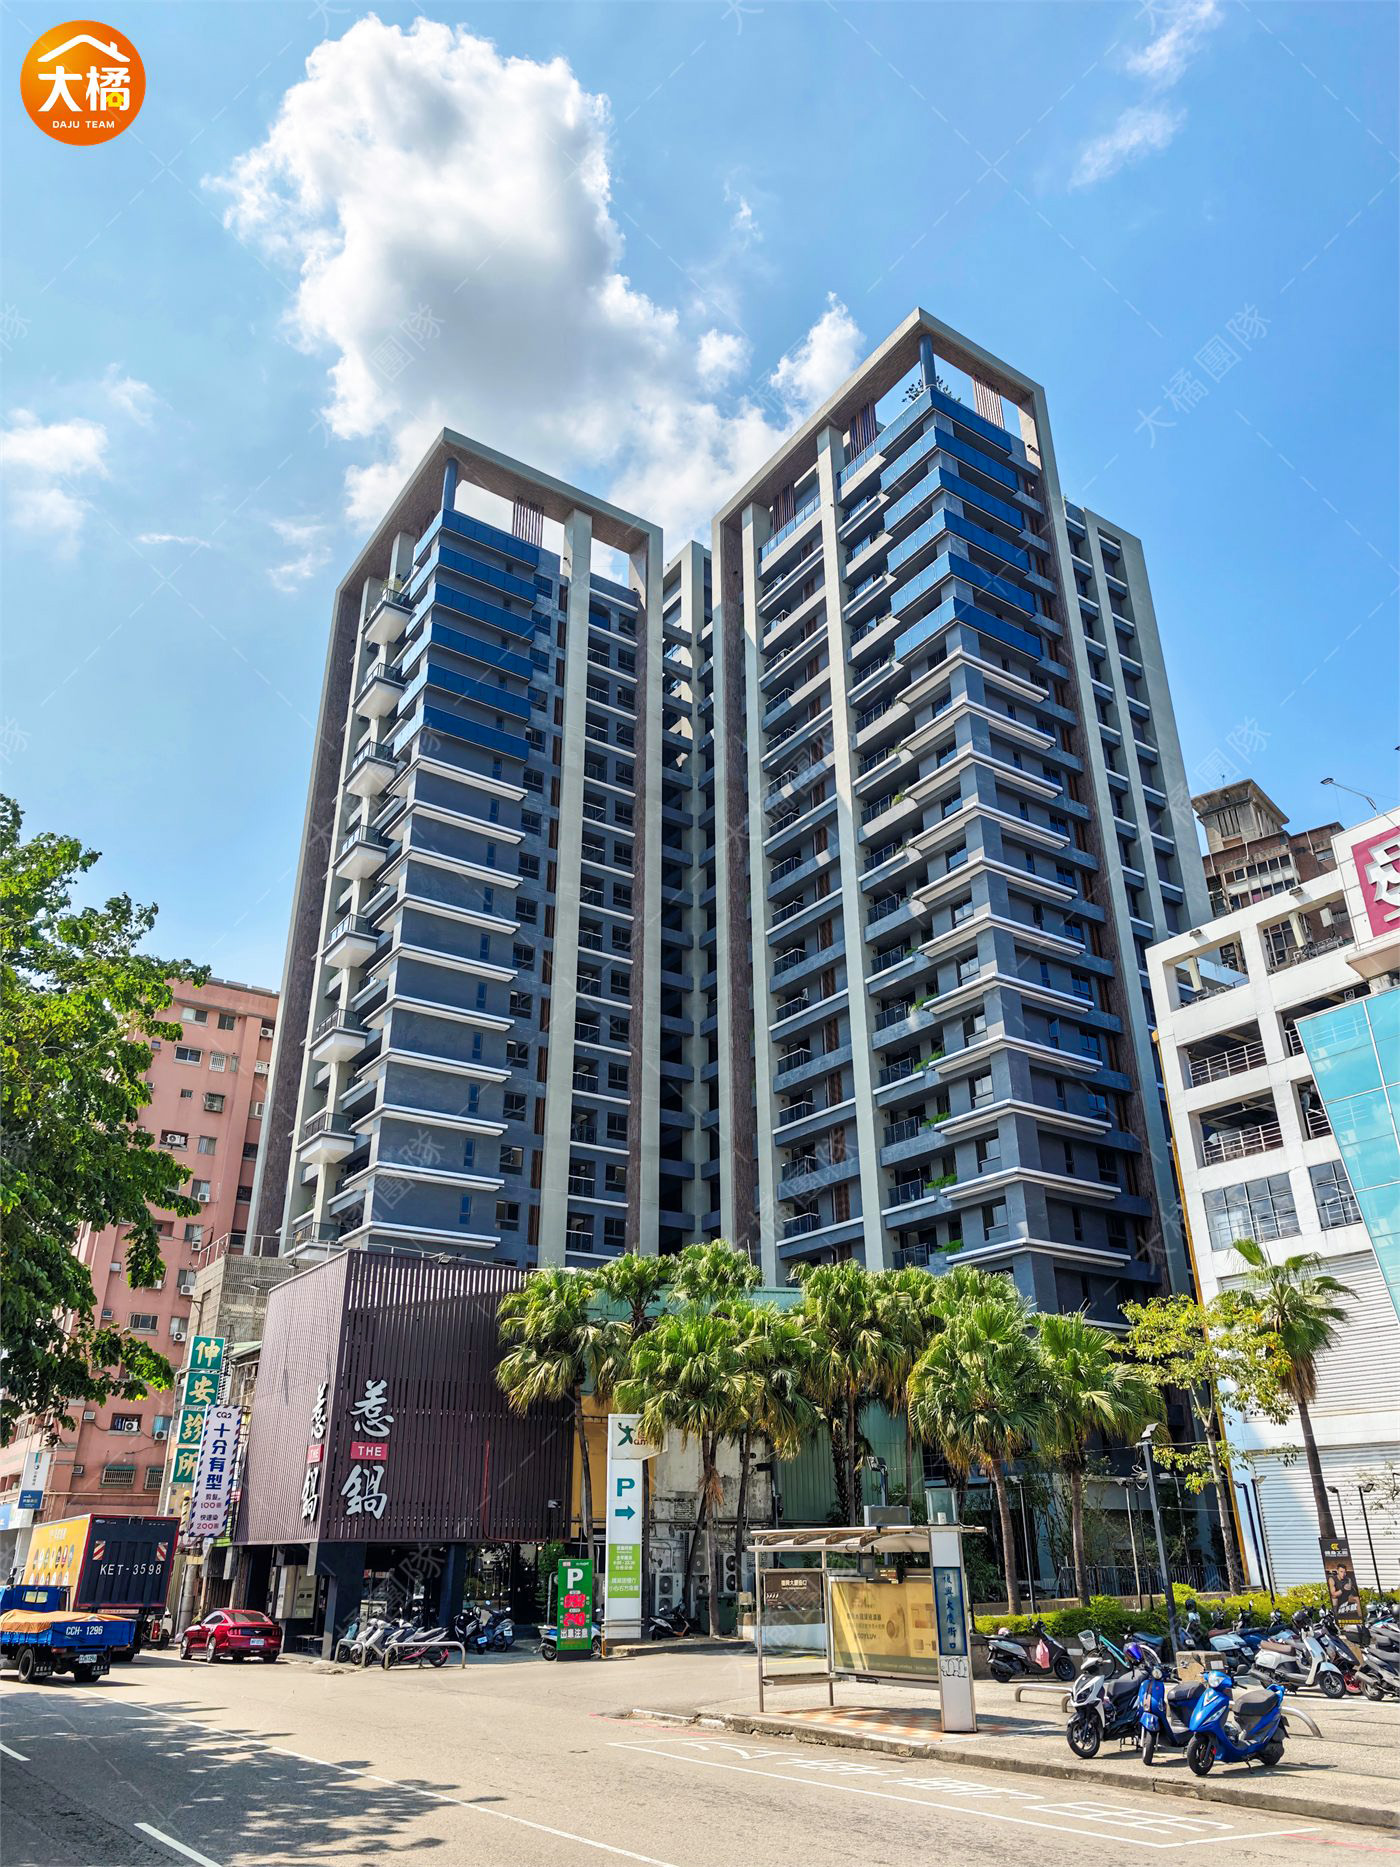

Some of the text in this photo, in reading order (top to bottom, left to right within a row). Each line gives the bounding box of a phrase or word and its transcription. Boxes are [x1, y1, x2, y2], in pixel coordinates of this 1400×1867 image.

[350, 1379, 394, 1437] 惹
[205, 1423, 231, 1490] 十分有型
[357, 1446, 383, 1457] THE
[340, 1464, 388, 1520] 鍋
[616, 1477, 636, 1497] P
[99, 1563, 162, 1576] KET-3598
[567, 1568, 584, 1589] P
